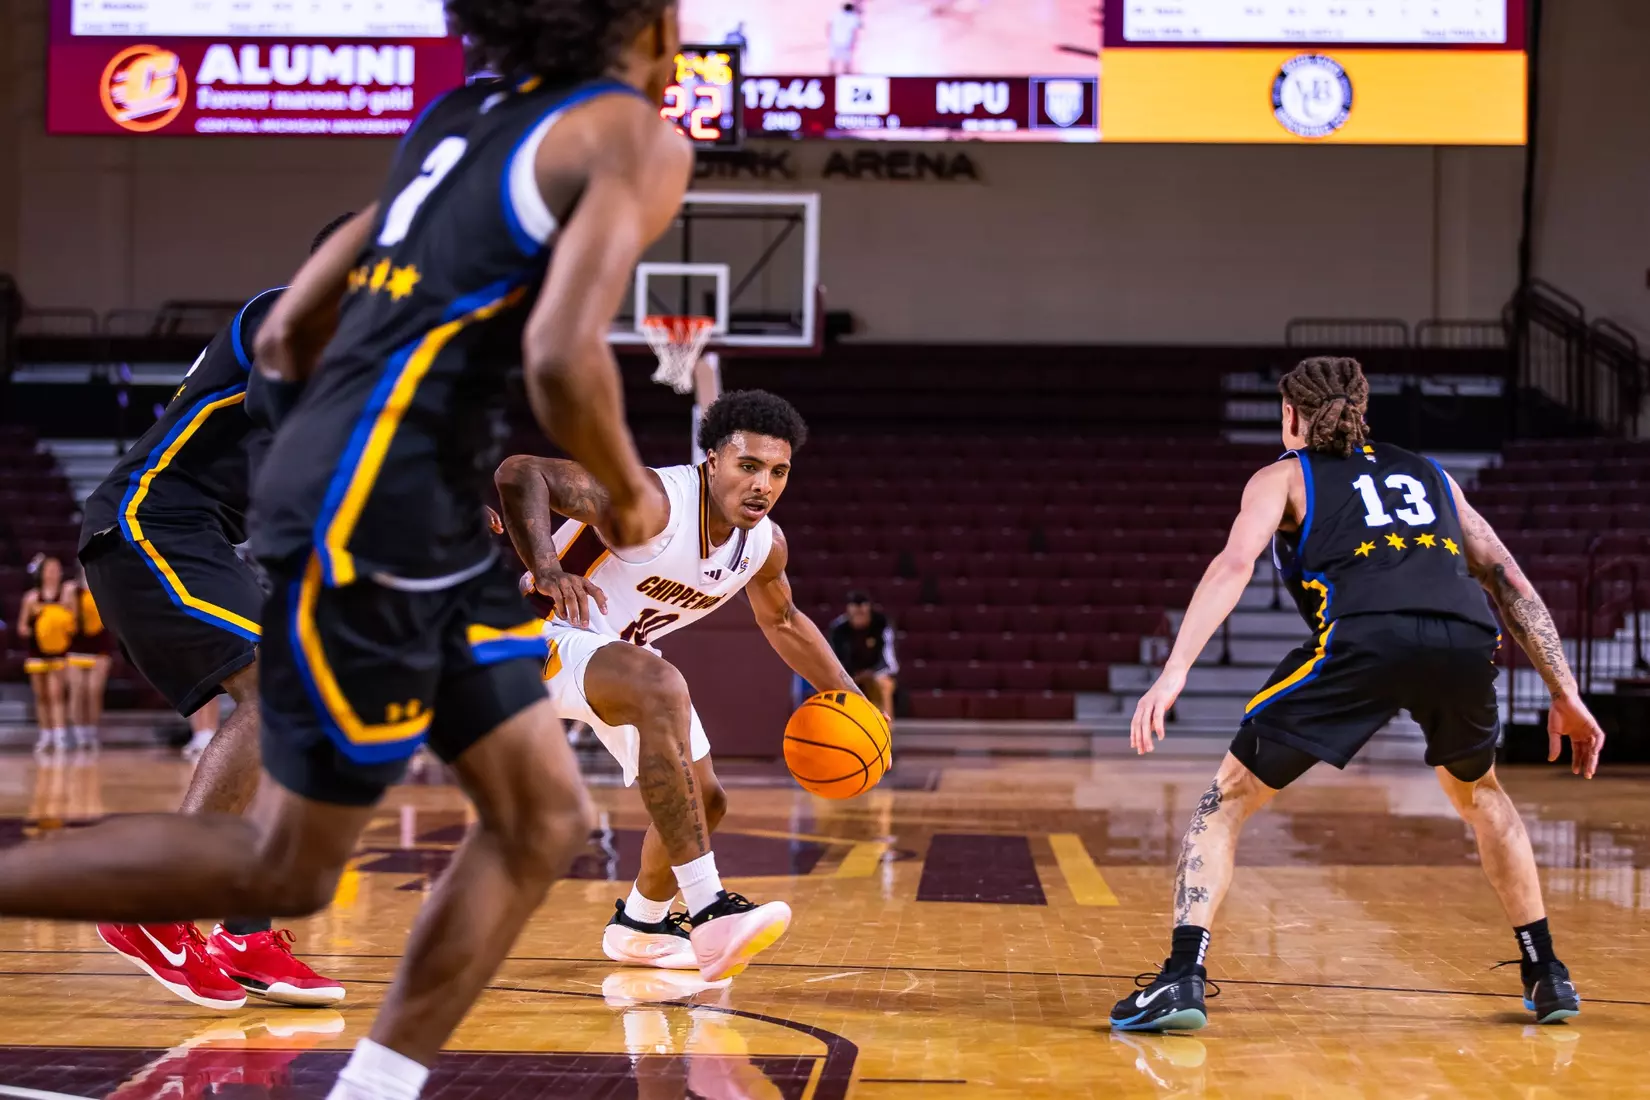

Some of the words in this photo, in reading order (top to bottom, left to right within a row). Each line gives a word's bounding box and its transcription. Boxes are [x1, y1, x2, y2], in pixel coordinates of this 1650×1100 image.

[196, 44, 415, 85] ALUMNI
[936, 81, 1010, 115] NPU
[820, 147, 980, 181] ARENA
[1350, 472, 1437, 527] 13
[620, 607, 680, 647] 10
